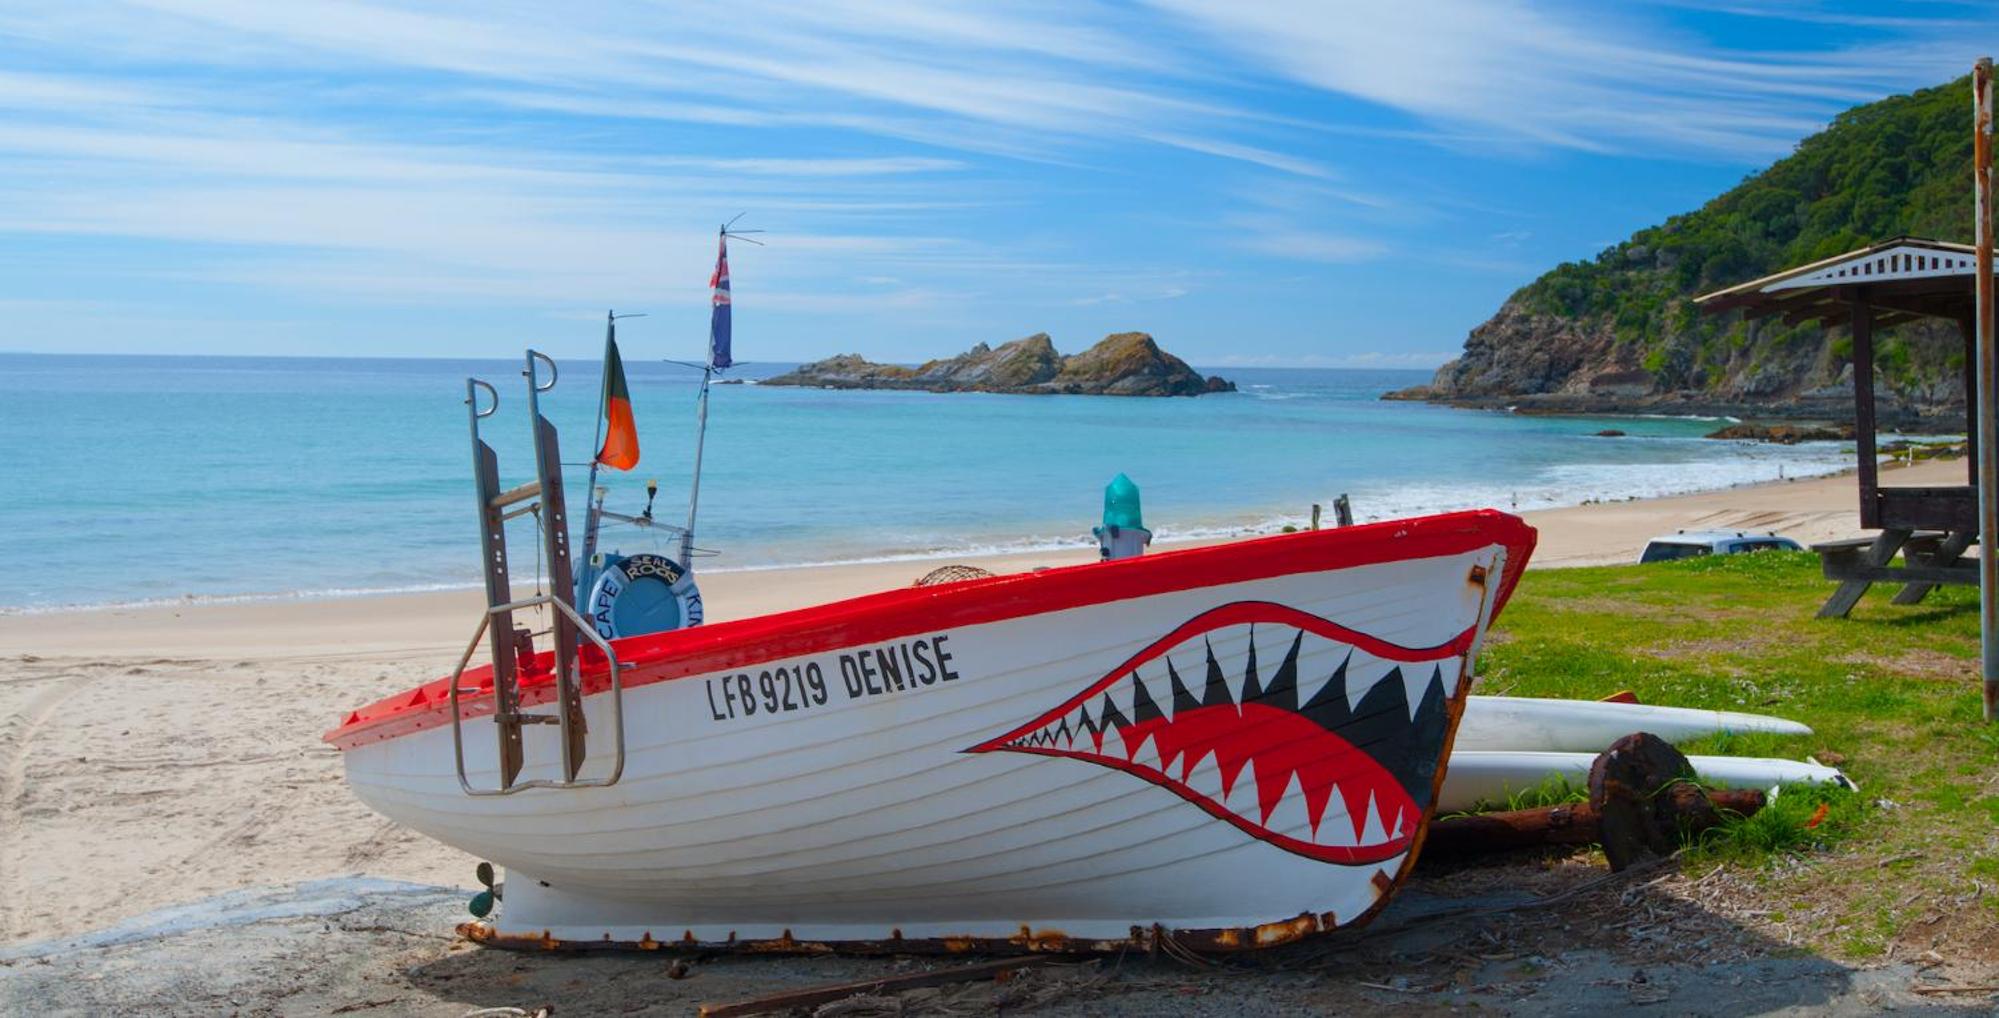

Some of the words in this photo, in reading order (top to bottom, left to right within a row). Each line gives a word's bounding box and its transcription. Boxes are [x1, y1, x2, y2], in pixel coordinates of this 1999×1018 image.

[630, 555, 673, 570] SEAL
[596, 580, 618, 640] CAPE
[839, 635, 959, 699] DENISE
